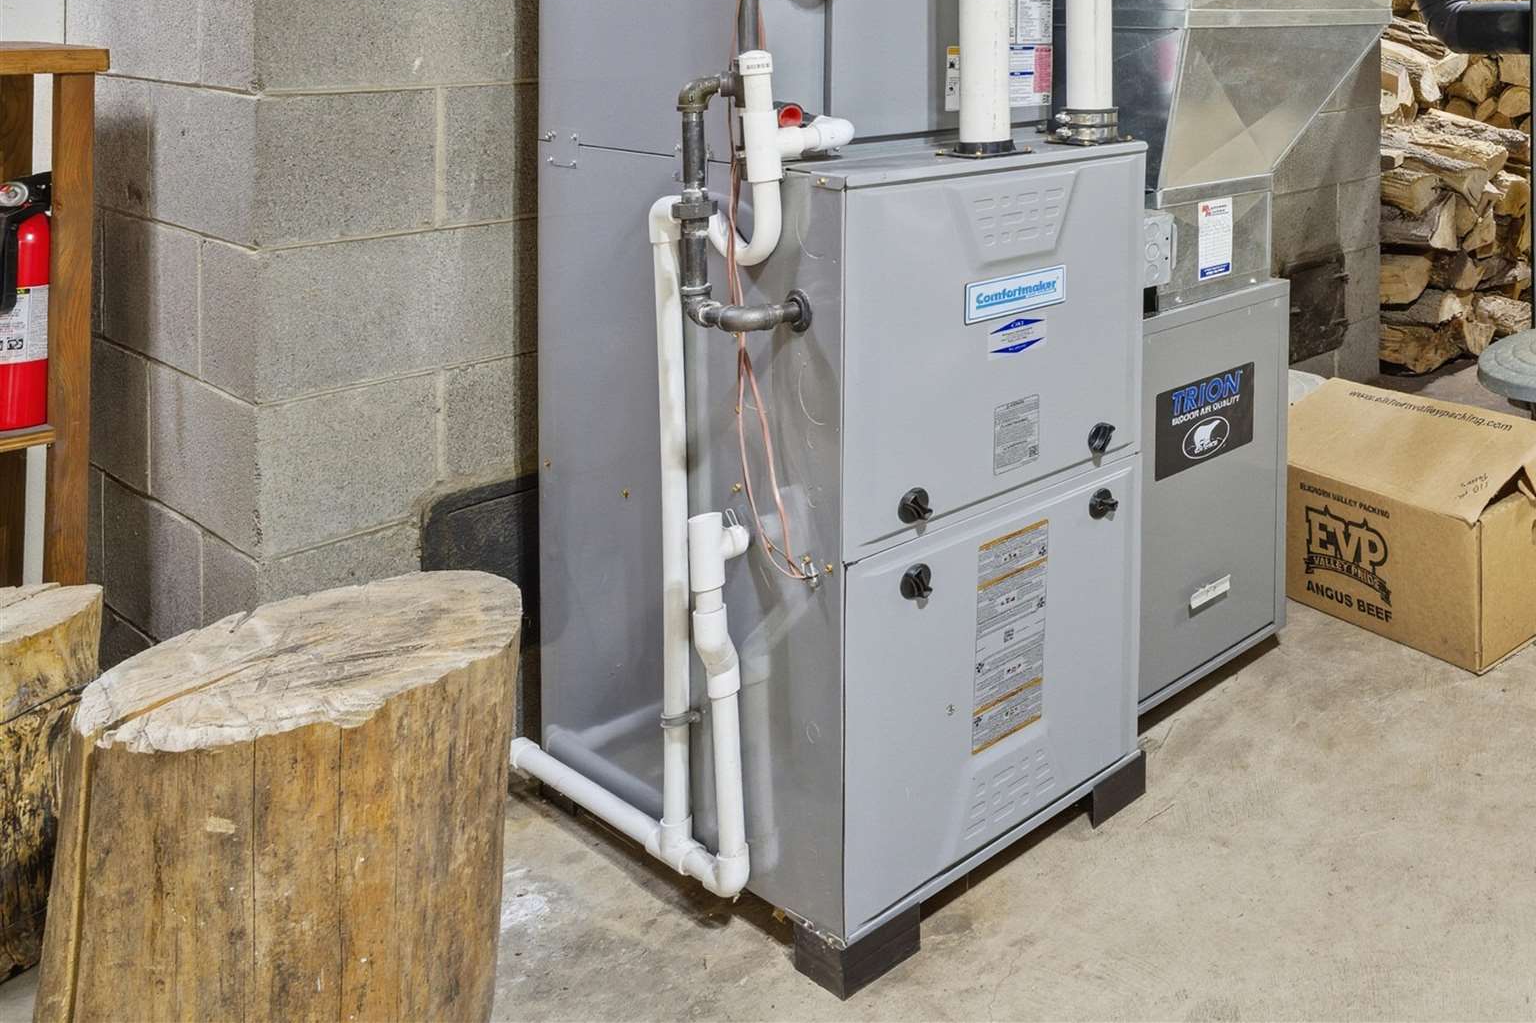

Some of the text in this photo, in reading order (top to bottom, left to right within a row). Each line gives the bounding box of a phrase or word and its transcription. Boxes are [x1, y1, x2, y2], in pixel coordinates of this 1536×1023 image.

[975, 280, 1056, 305] Comfortmaker
[1172, 369, 1241, 416] TRION
[1200, 404, 1212, 416] AIR
[1213, 394, 1241, 411] QUALITY
[1305, 505, 1389, 575] EVP
[1306, 579, 1393, 624] ANGUS BEEF
